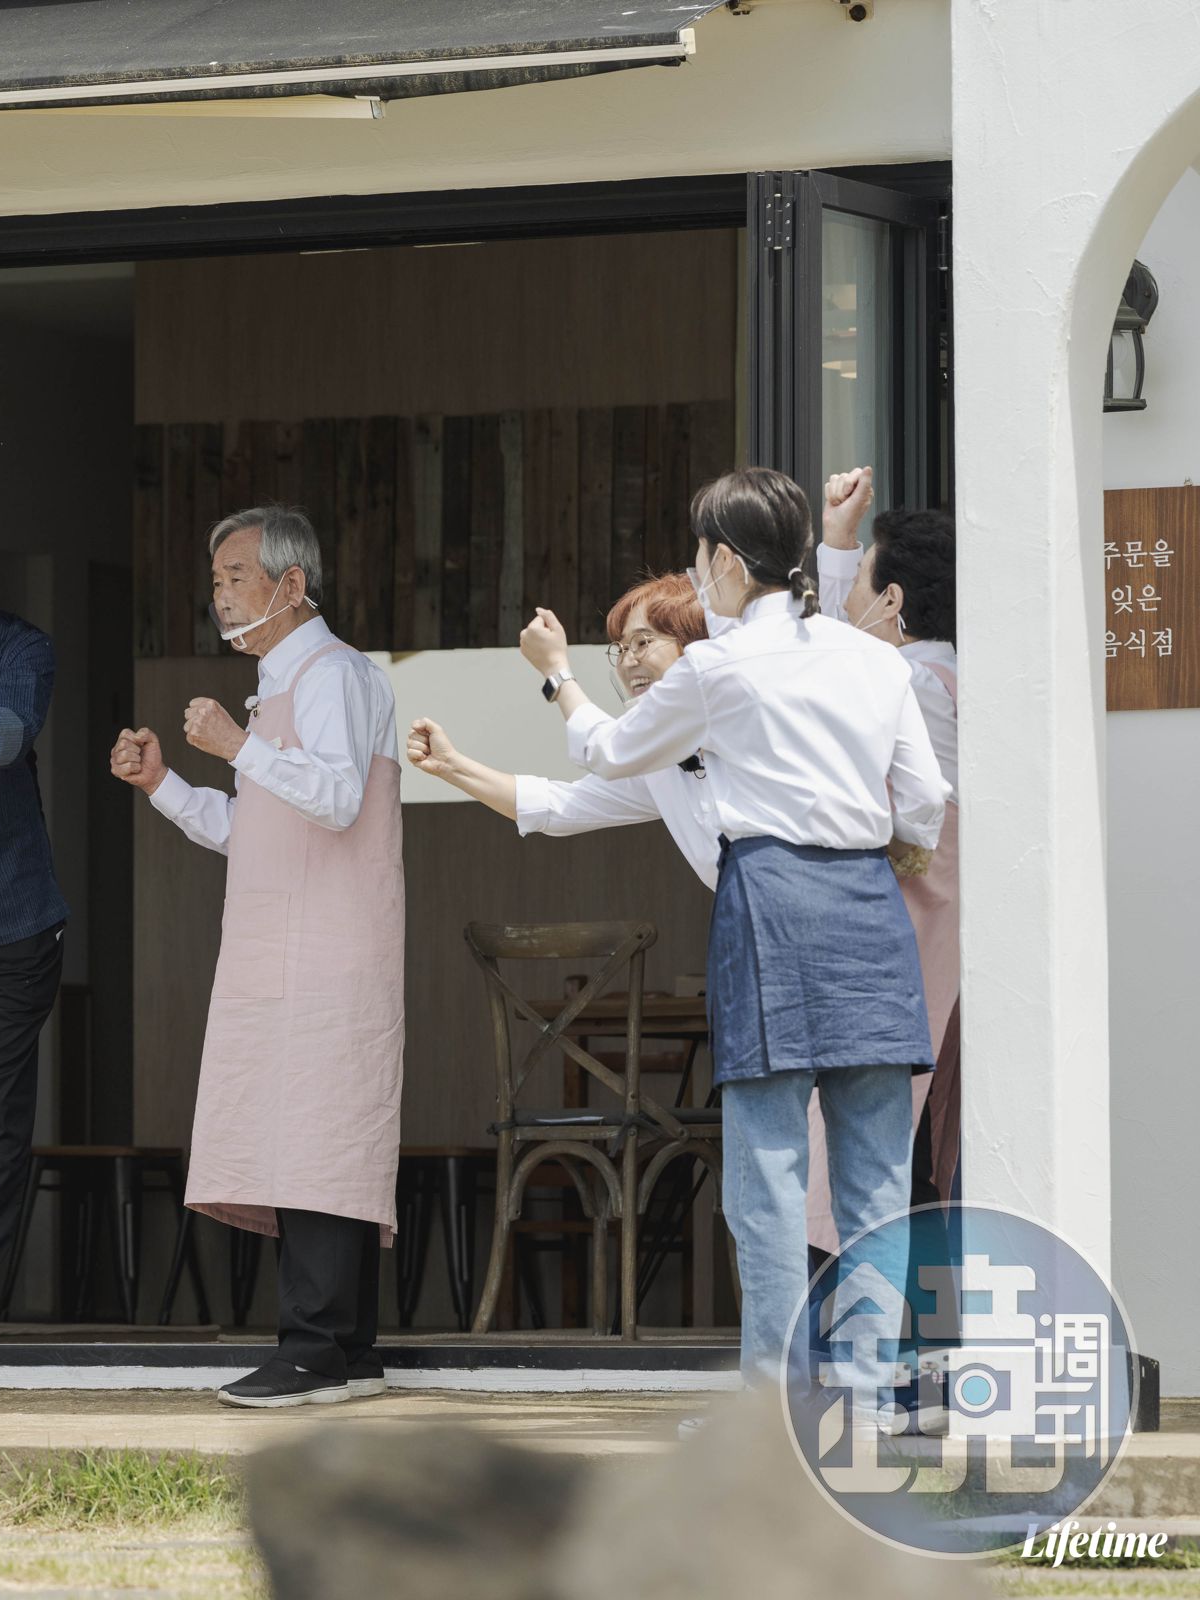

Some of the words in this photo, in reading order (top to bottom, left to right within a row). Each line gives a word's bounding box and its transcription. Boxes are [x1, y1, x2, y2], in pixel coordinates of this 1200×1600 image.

[1104, 538, 1175, 570] 주문을
[1111, 583, 1162, 615] 잊은
[1105, 627, 1173, 658] 음식점
